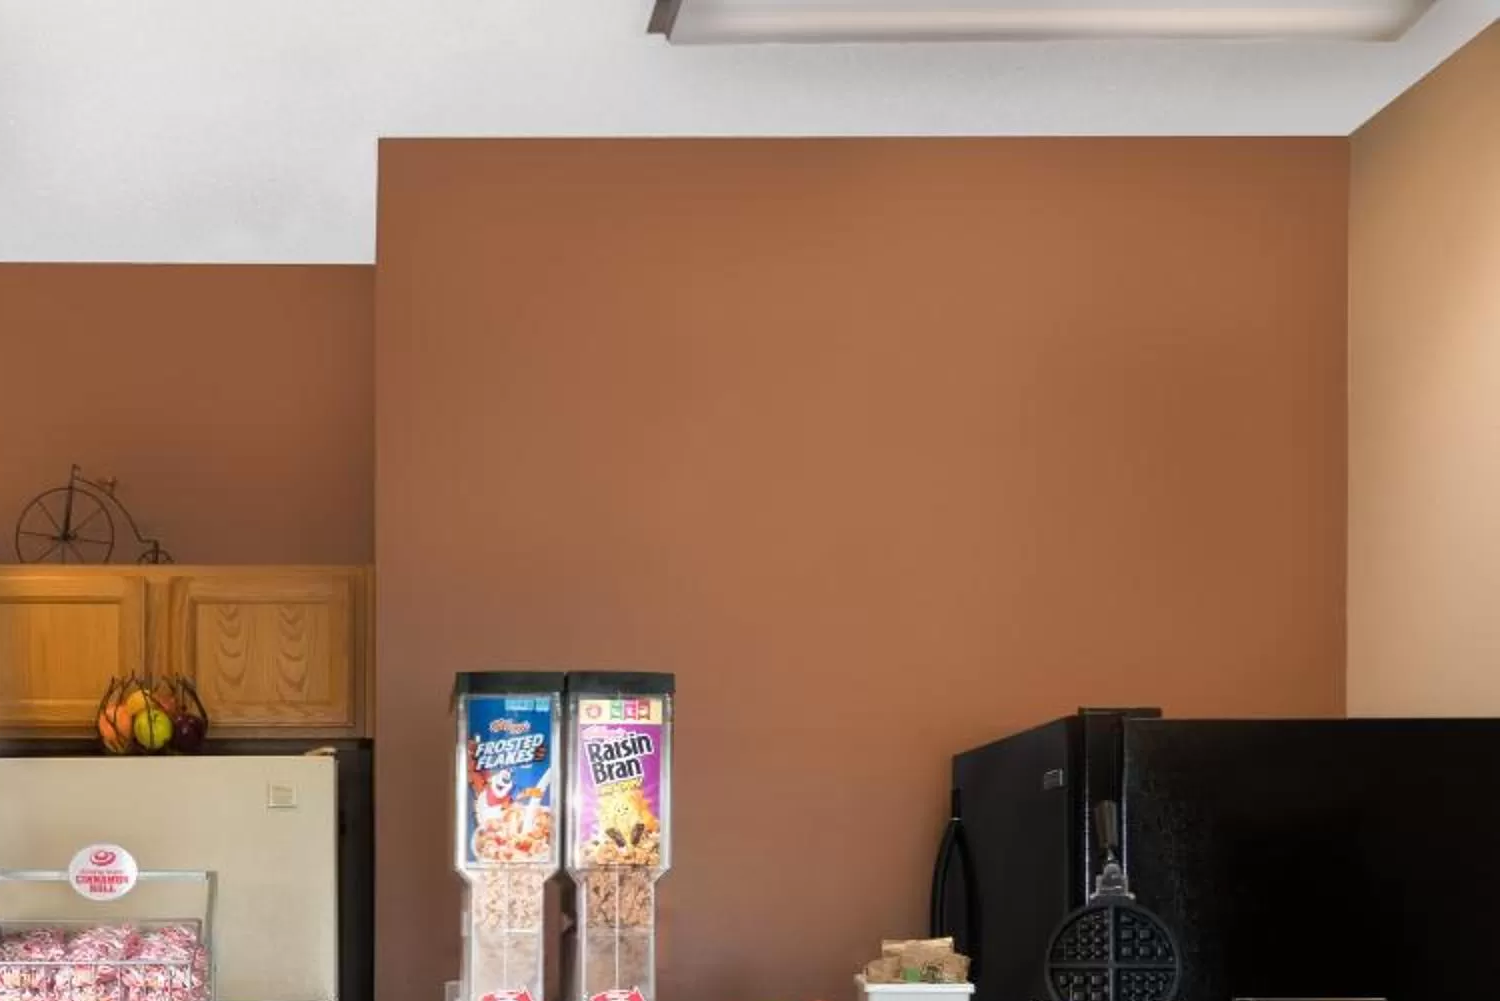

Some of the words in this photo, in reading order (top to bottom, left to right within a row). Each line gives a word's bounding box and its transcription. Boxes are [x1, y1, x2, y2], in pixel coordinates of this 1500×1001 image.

[476, 733, 545, 757] FROSTED
[587, 733, 653, 763] Raisin
[476, 748, 536, 771] FLAKES
[592, 758, 642, 784] Bran
